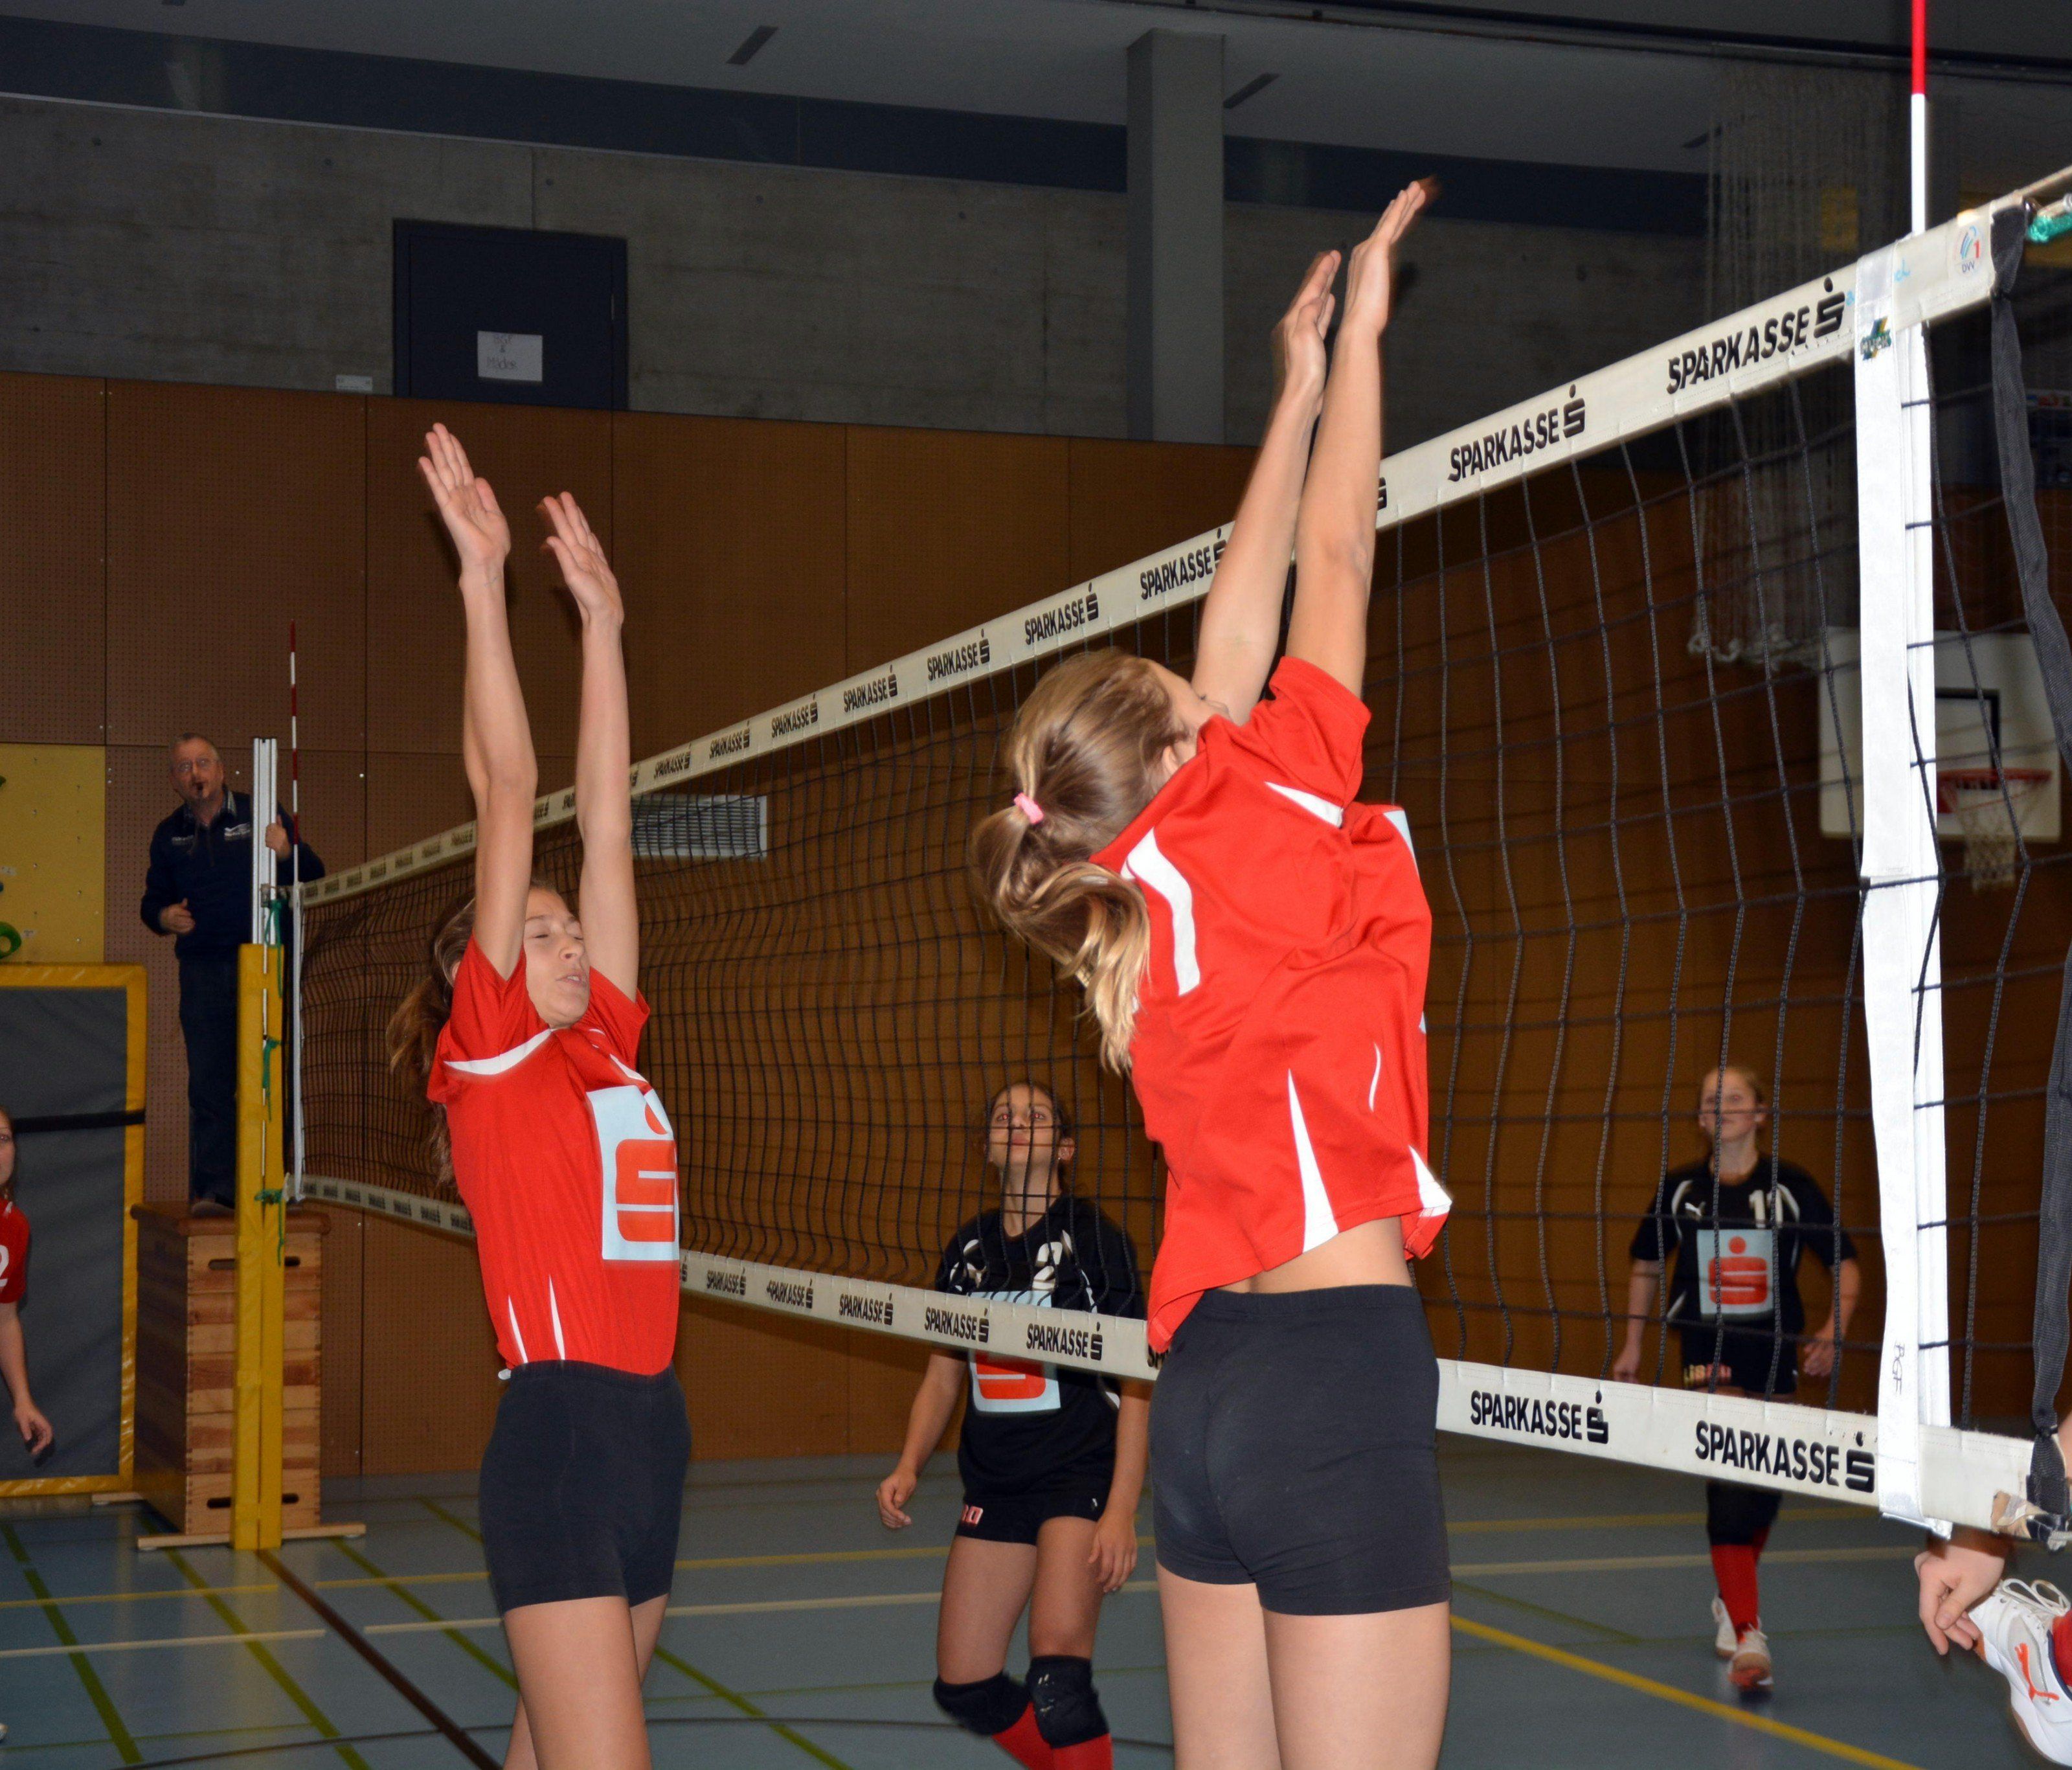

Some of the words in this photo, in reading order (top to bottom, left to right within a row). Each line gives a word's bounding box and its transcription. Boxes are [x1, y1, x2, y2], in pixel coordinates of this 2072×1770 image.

[1667, 306, 1810, 395] SPARKASSE
[1448, 407, 1559, 482] SPARKASSE
[1140, 545, 1213, 601] SPARKASSE
[1024, 598, 1086, 646] SPARKASSE
[927, 642, 978, 682] SPARKASSE
[843, 677, 888, 712] SPARKASSE
[771, 708, 809, 738] SPARKASSE
[709, 732, 743, 760] SPARKASSE
[706, 1269, 739, 1294] SPARKASSE
[767, 1279, 805, 1307] SPARKASSE
[839, 1293, 883, 1326] SPARKASSE
[925, 1307, 977, 1341] SPARKASSE
[1026, 1322, 1089, 1359] SPARKASSE
[1470, 1389, 1583, 1440] SPARKASSE
[1695, 1420, 1840, 1486] SPARKASSE
